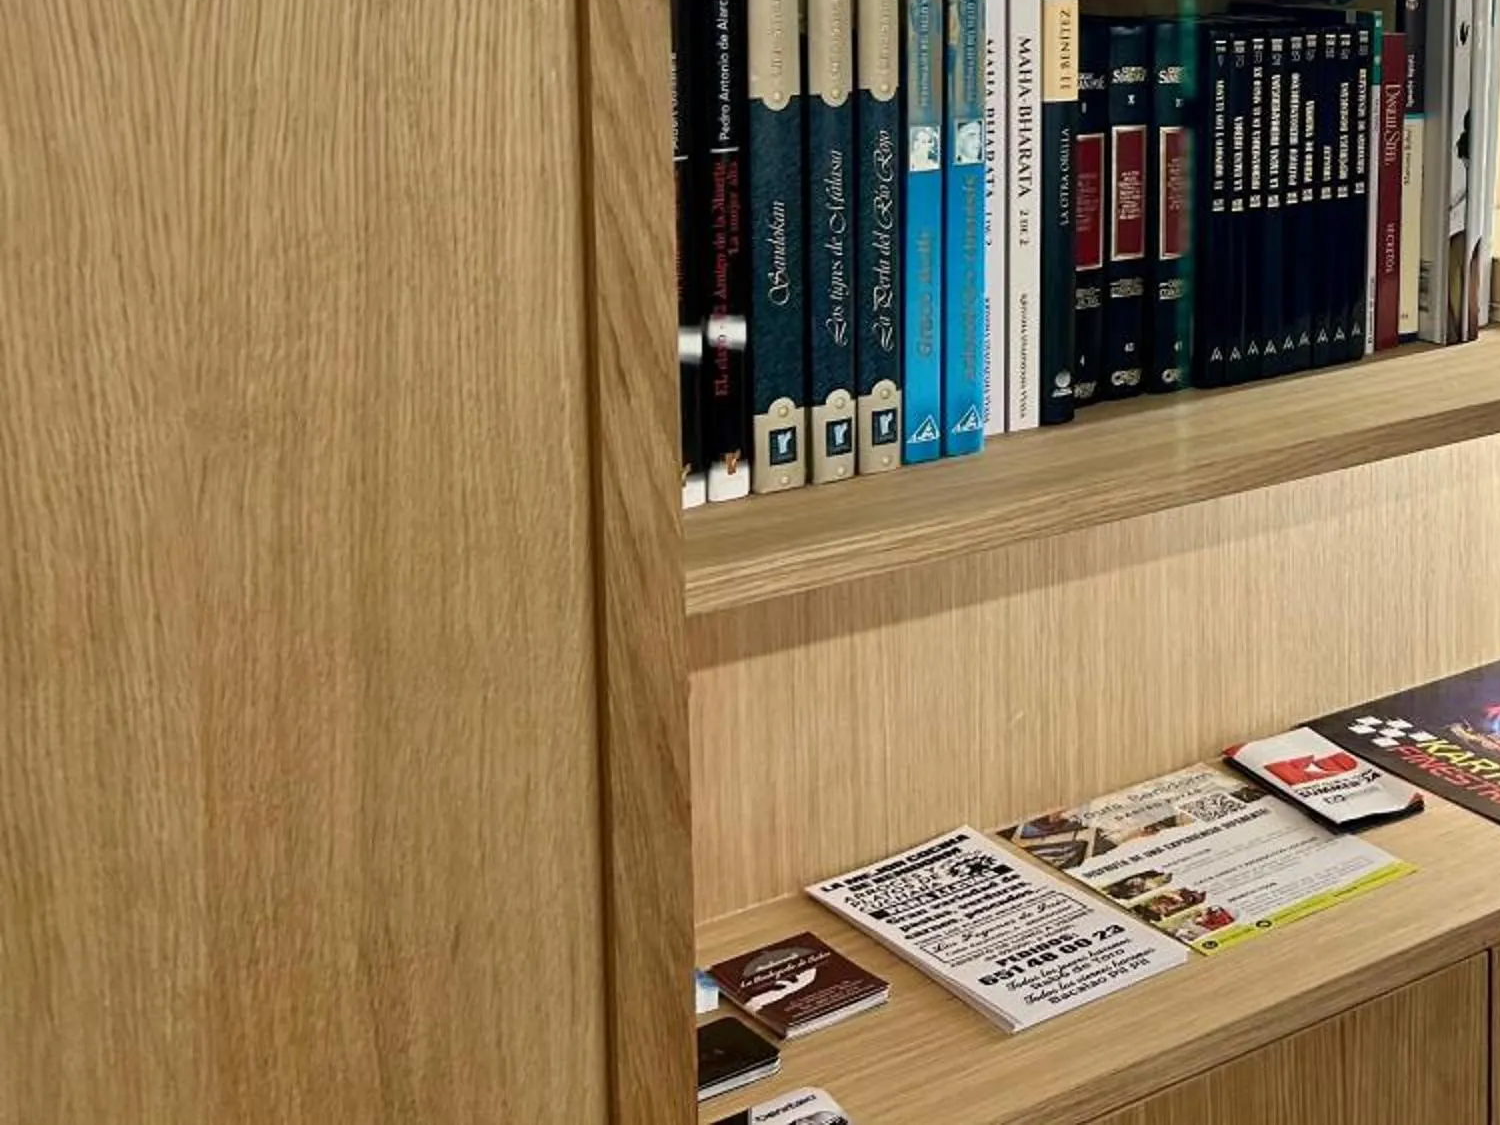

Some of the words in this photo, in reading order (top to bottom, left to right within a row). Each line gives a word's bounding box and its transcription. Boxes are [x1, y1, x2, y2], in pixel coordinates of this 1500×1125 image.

[717, 33, 729, 50] de
[1058, 9, 1071, 69] BENÍTEZ
[718, 52, 731, 101] Antonio
[718, 104, 731, 141] Pedro
[1017, 37, 1033, 198] MAHA-BHARATA
[874, 130, 896, 182] Rojo
[874, 184, 894, 230] Río
[765, 200, 791, 306] Sandokan
[825, 235, 844, 257] de
[873, 231, 890, 257] del
[827, 259, 848, 302] tigres
[873, 258, 892, 310] Perla
[825, 304, 848, 347] Los
[873, 315, 894, 351] La
[820, 882, 844, 892] LA
[906, 834, 970, 862] COCINA
[886, 908, 928, 924] Gran
[930, 881, 998, 910] variedad
[1027, 952, 1059, 968] 48
[1059, 938, 1092, 954] 00
[1092, 924, 1126, 939] 23
